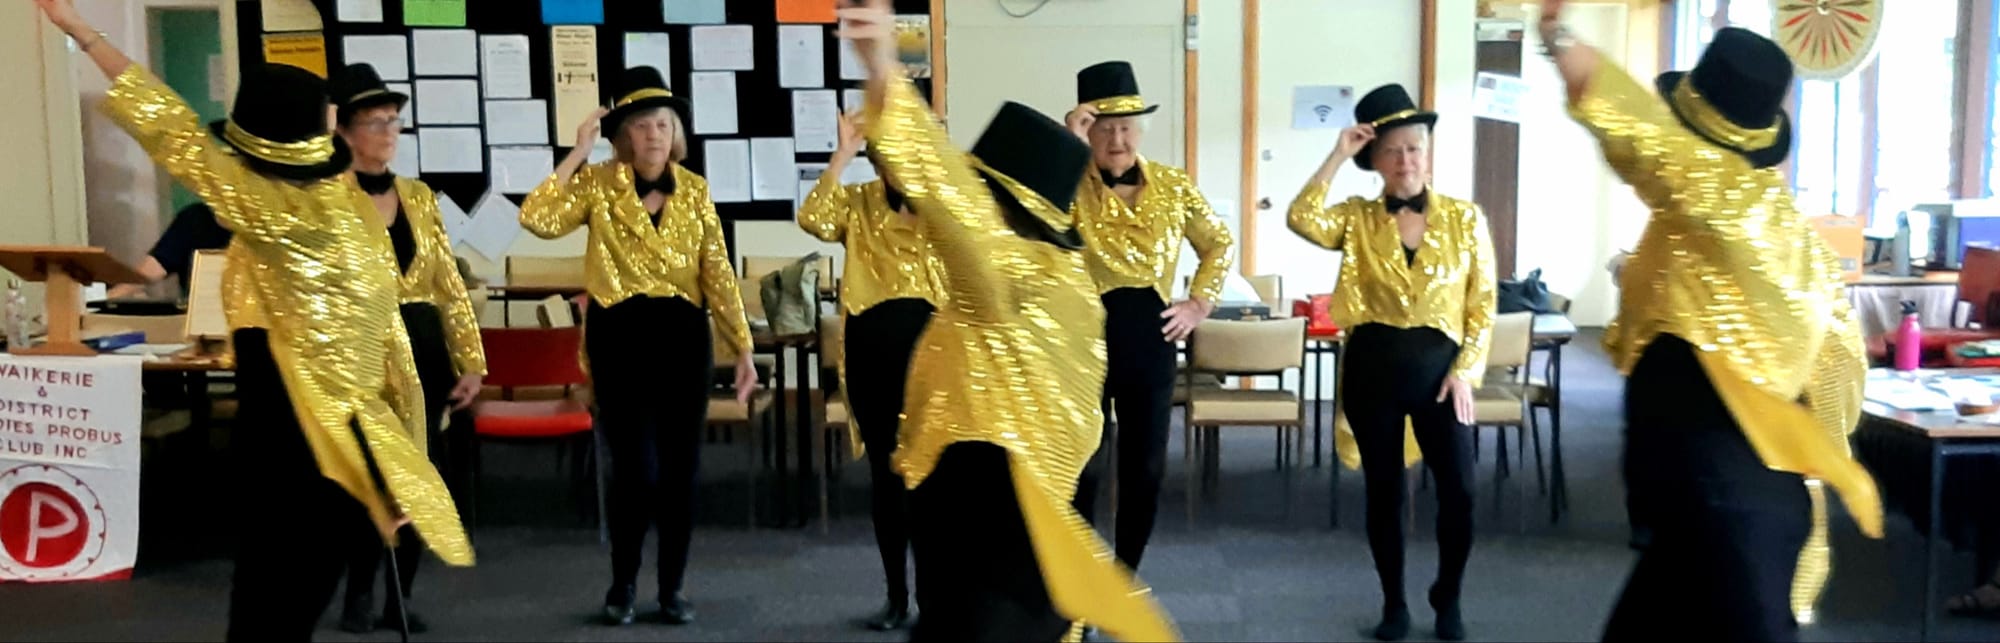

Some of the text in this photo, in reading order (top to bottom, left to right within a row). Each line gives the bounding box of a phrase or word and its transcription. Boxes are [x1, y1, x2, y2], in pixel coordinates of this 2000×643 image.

[38, 385, 48, 397] &
[48, 424, 122, 444] PROBUS
[0, 438, 87, 458] LUB INC
[26, 491, 79, 562] P
